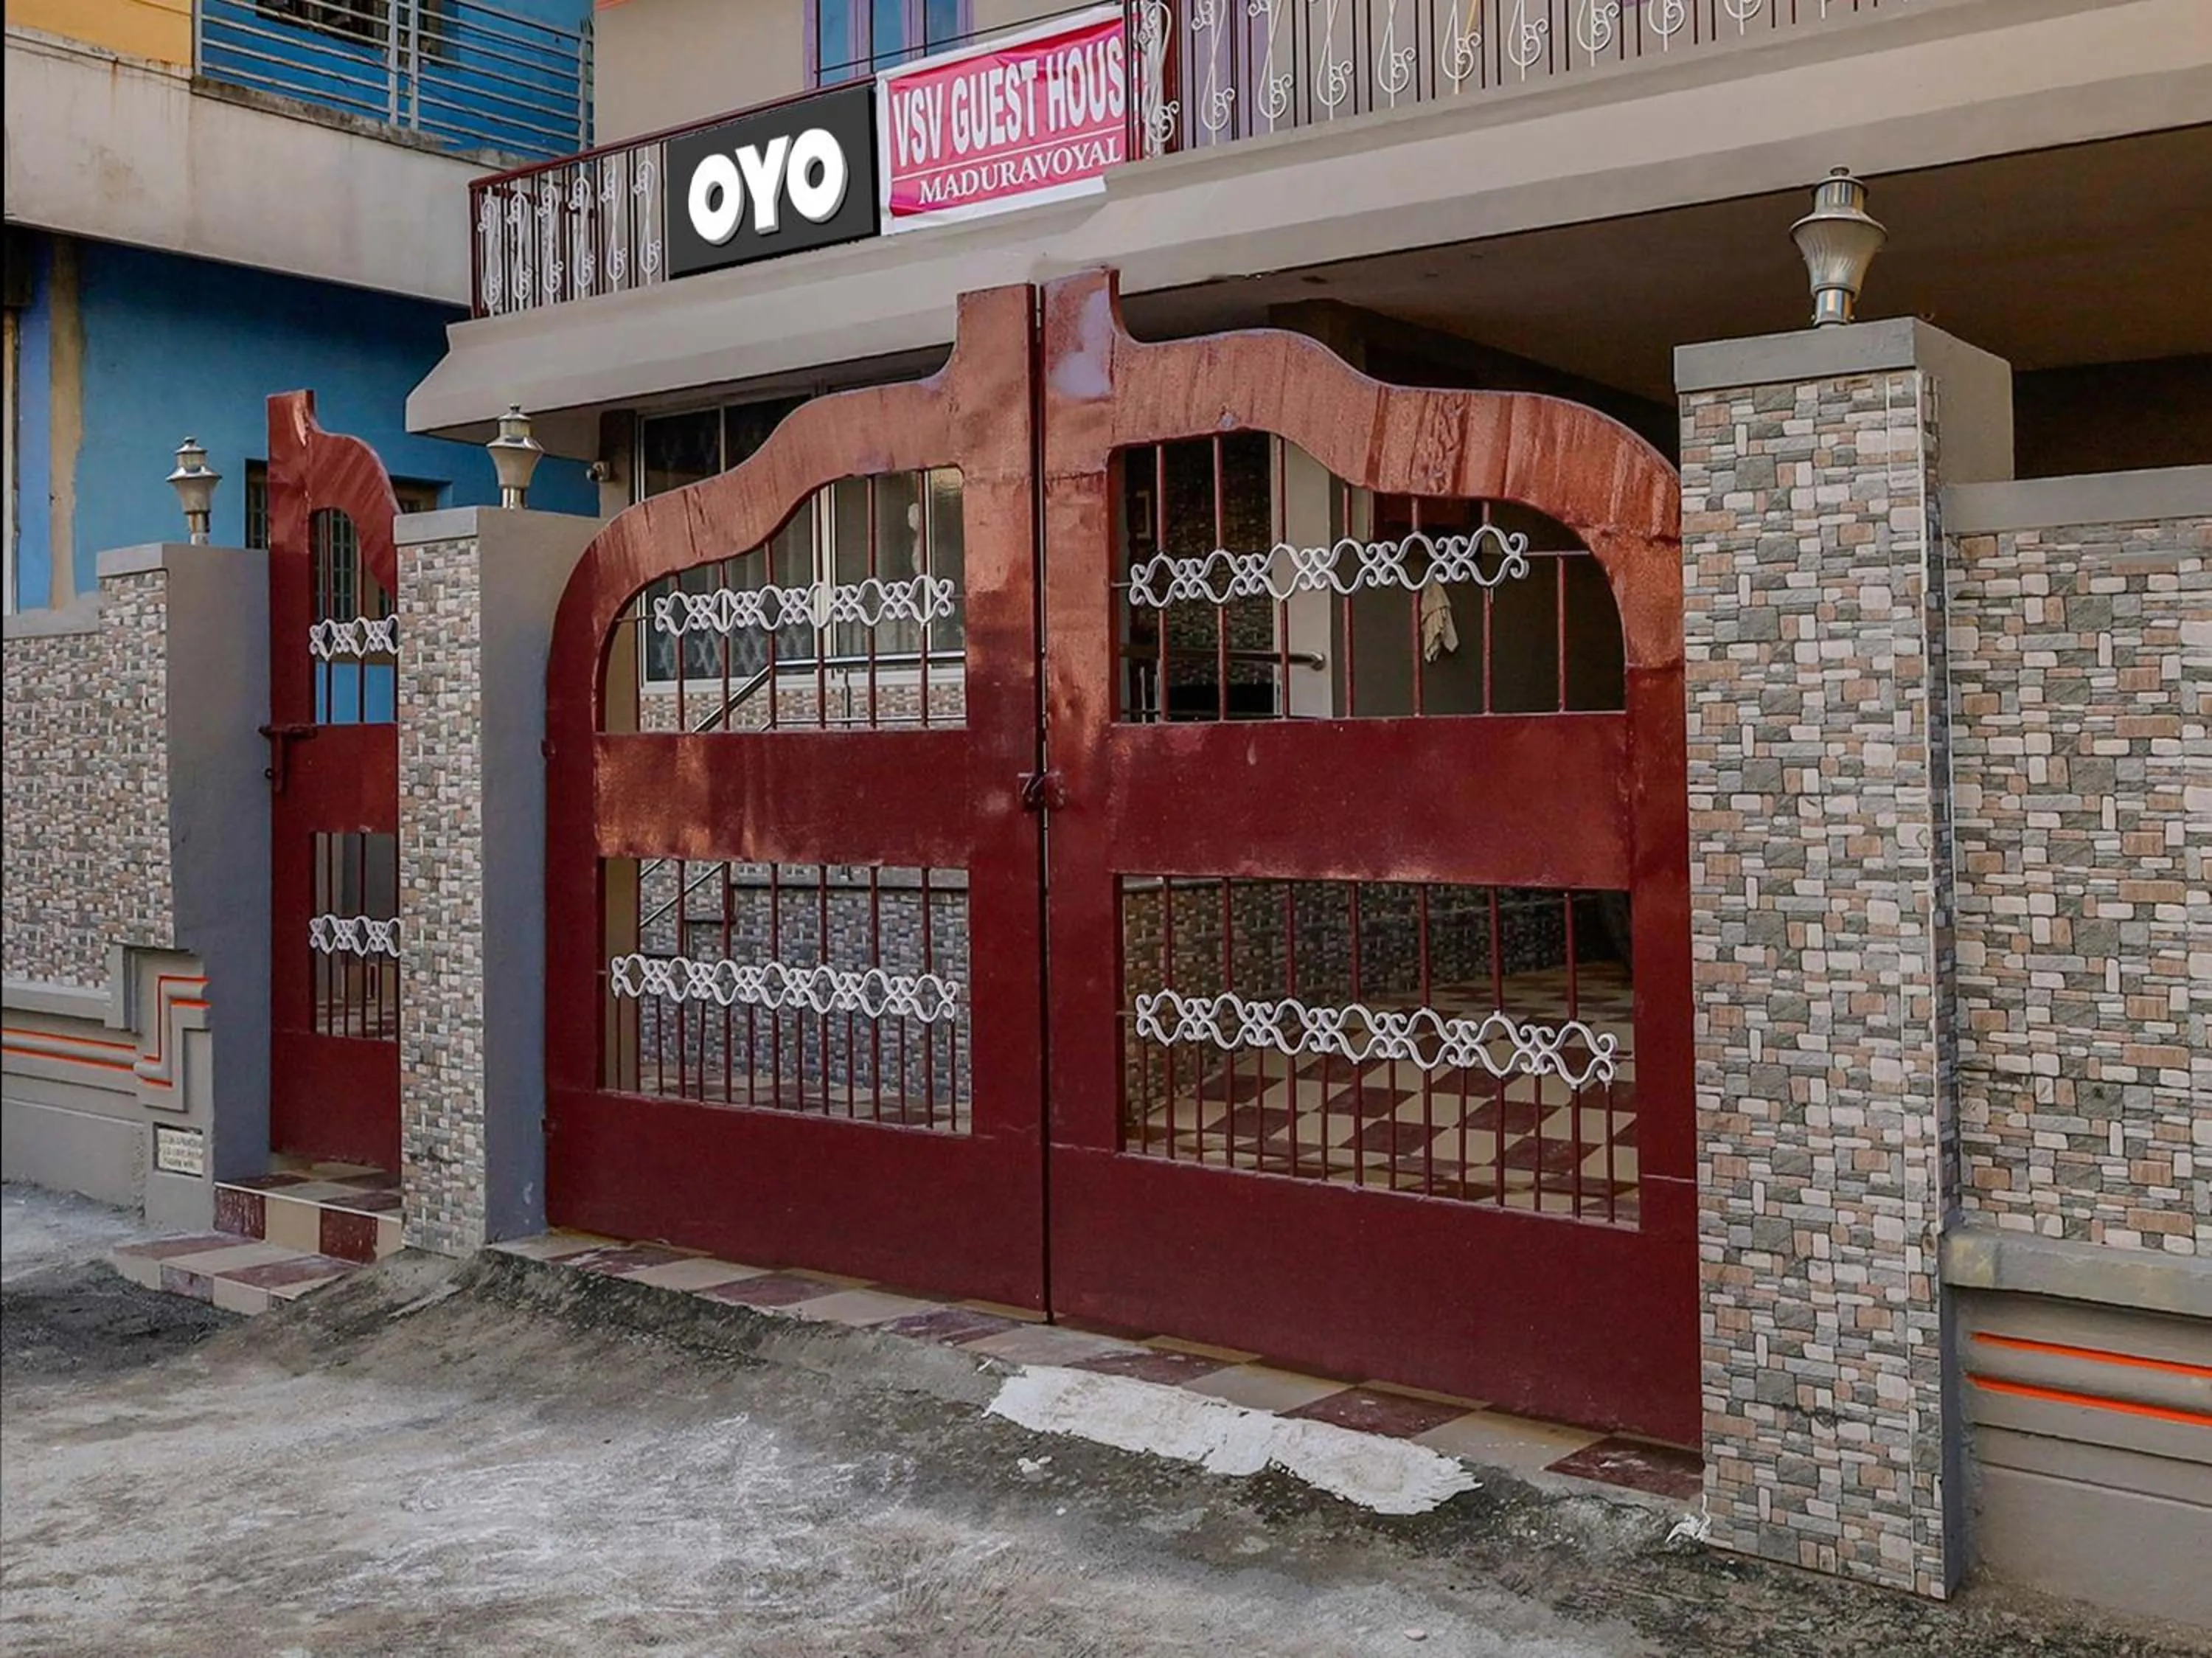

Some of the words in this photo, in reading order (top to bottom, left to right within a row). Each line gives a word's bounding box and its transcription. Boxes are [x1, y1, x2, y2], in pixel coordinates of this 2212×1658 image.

[893, 83, 943, 168] VSV
[950, 60, 1037, 155] GUEST
[1046, 33, 1140, 133] HOUS
[688, 128, 849, 246] OYO
[919, 136, 1121, 204] MADURAVOYAL
